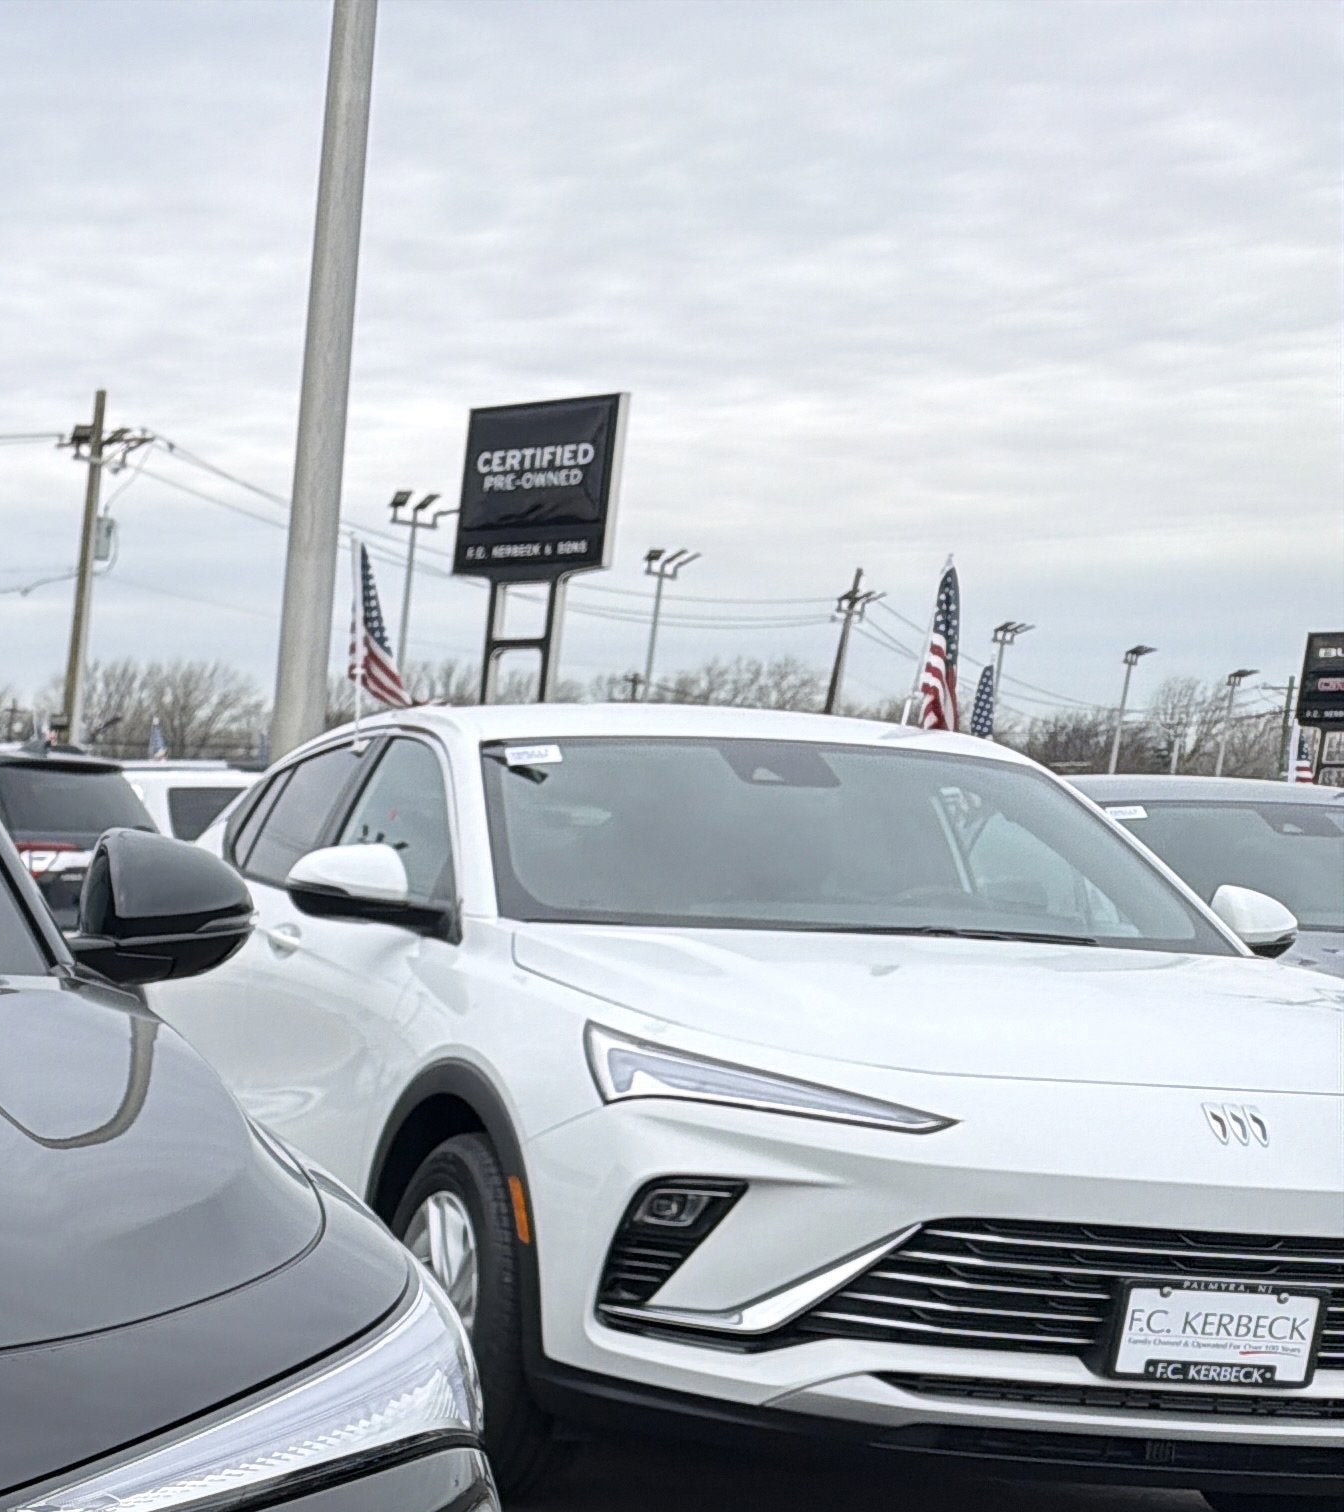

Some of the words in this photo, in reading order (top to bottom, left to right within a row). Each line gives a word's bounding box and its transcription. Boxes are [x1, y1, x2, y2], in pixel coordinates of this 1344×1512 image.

[477, 442, 594, 473] CERTIFIED
[482, 468, 583, 491] PRE-OWNED
[1183, 1281, 1252, 1294] PALMYRA,
[1258, 1285, 1274, 1294] NJ
[1128, 1308, 1172, 1334] F.C.
[1182, 1311, 1309, 1340] KERBECK
[1155, 1362, 1184, 1380] F.C.
[1187, 1364, 1266, 1384] KERBECK
